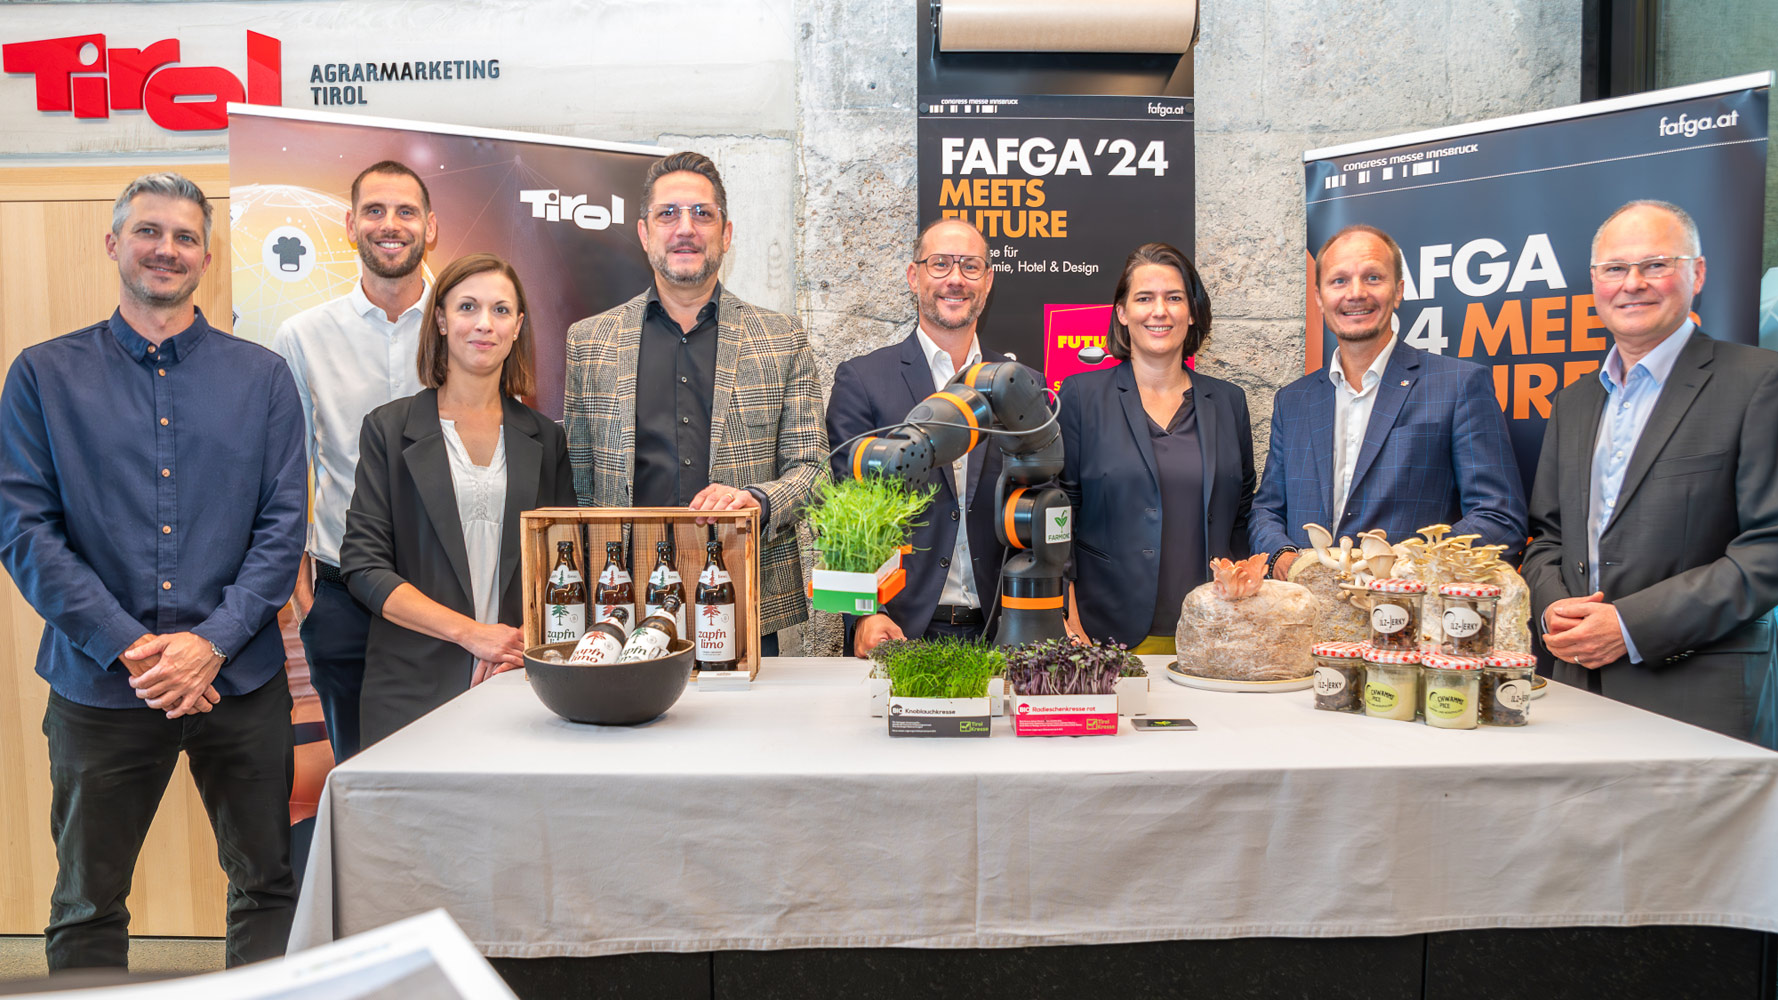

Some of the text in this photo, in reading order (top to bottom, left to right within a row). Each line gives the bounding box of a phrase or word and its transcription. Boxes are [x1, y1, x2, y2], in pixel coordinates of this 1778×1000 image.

[2, 29, 283, 131] Tirol
[310, 59, 500, 83] AGRARMARKETING
[310, 86, 368, 106] TIROL
[1148, 102, 1184, 117] fafga.at
[1659, 109, 1740, 138] fafga.at
[1343, 157, 1388, 172] congress
[1389, 151, 1424, 165] messe
[939, 178, 1046, 207] MEETS
[519, 188, 625, 230] Tirol
[1003, 245, 1019, 258] für
[1018, 260, 1046, 273] Hotel
[1049, 261, 1060, 273] &
[1063, 261, 1099, 276] Design
[1057, 335, 1107, 349] FUTU
[547, 629, 576, 641] zapfn
[698, 629, 727, 641] zapfn
[700, 639, 724, 649] limo
